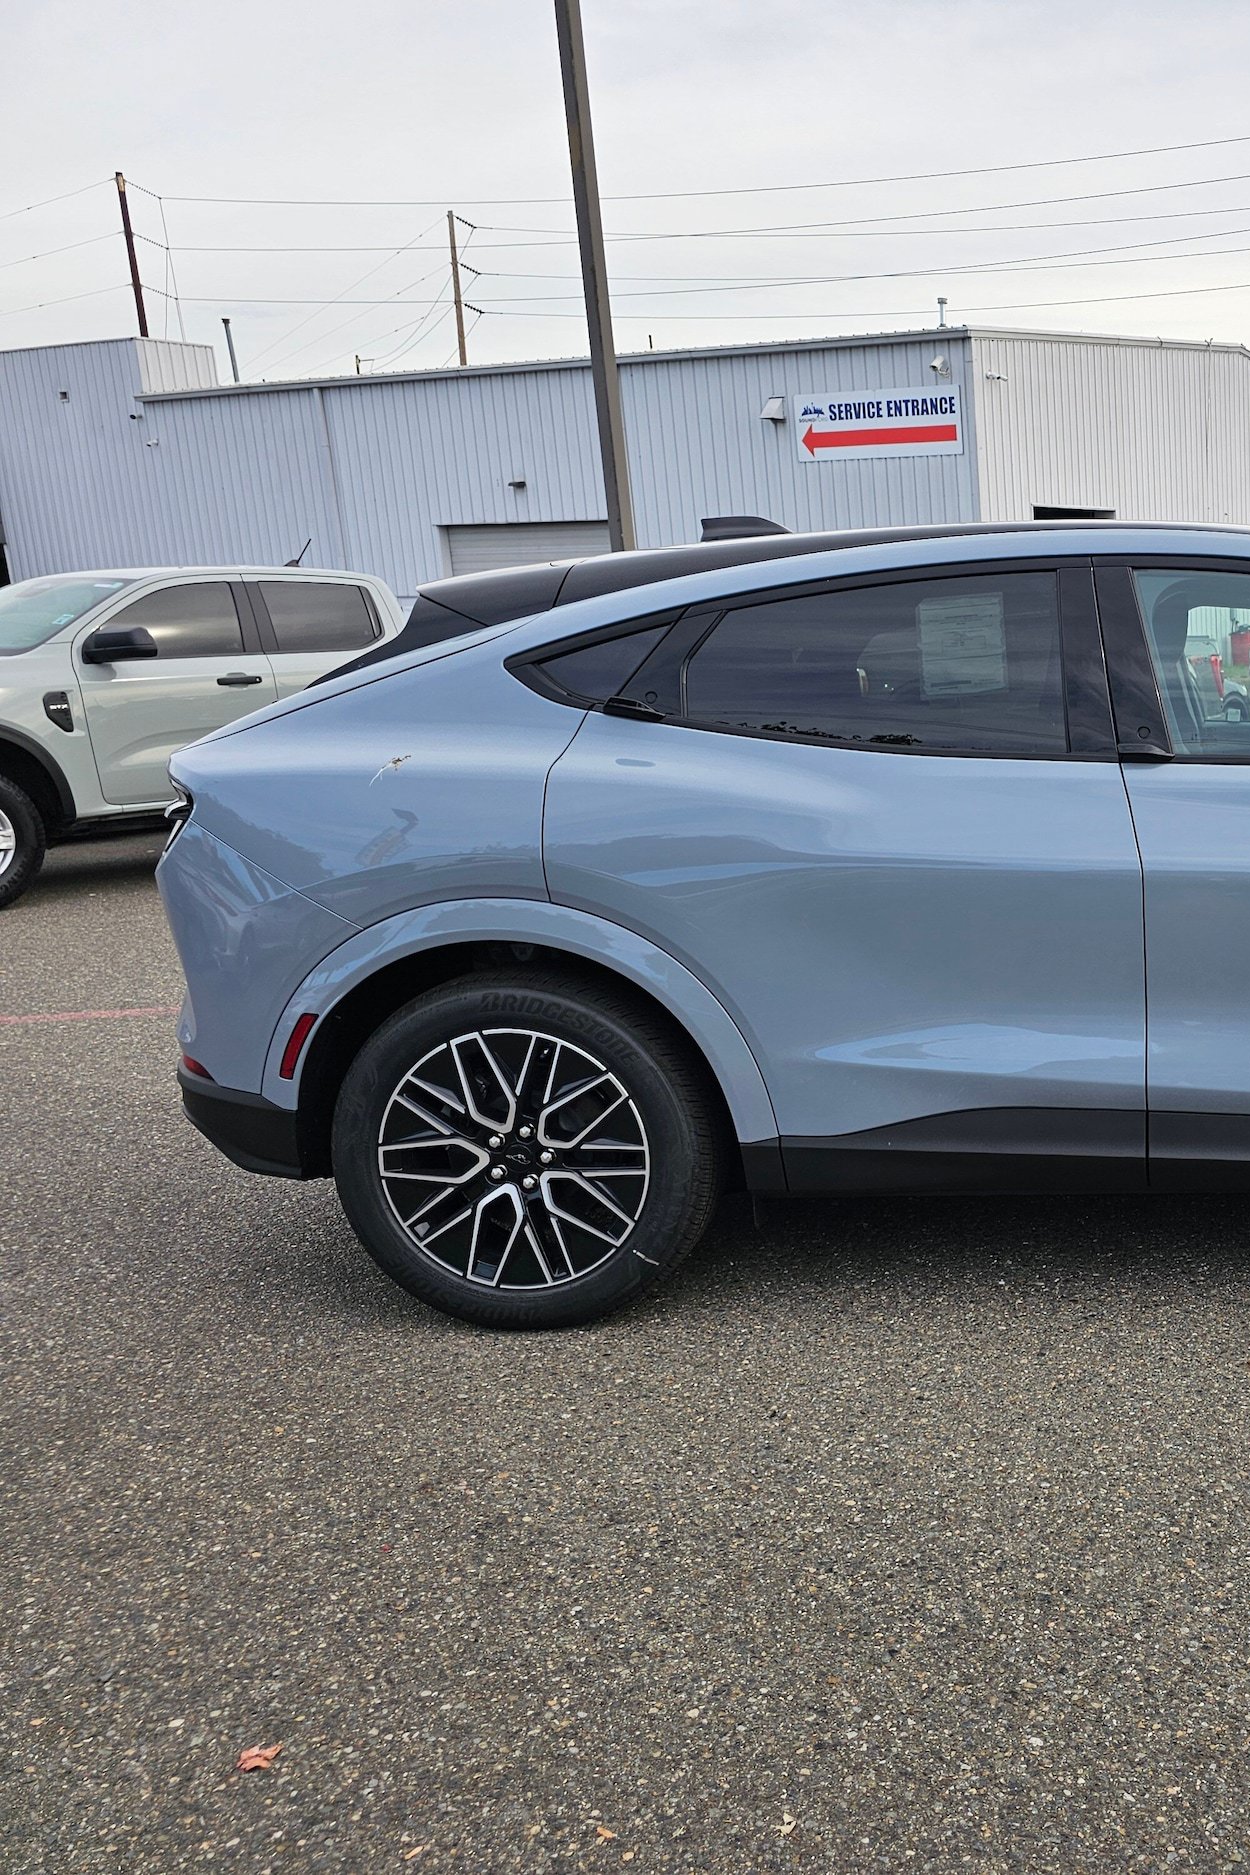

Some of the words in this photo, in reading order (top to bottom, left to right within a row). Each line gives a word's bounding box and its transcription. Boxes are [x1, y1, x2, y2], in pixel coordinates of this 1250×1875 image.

[828, 400, 883, 421] SERVICE
[886, 396, 956, 418] ENTRANCE
[479, 991, 642, 1068] BRIDGESTONE
